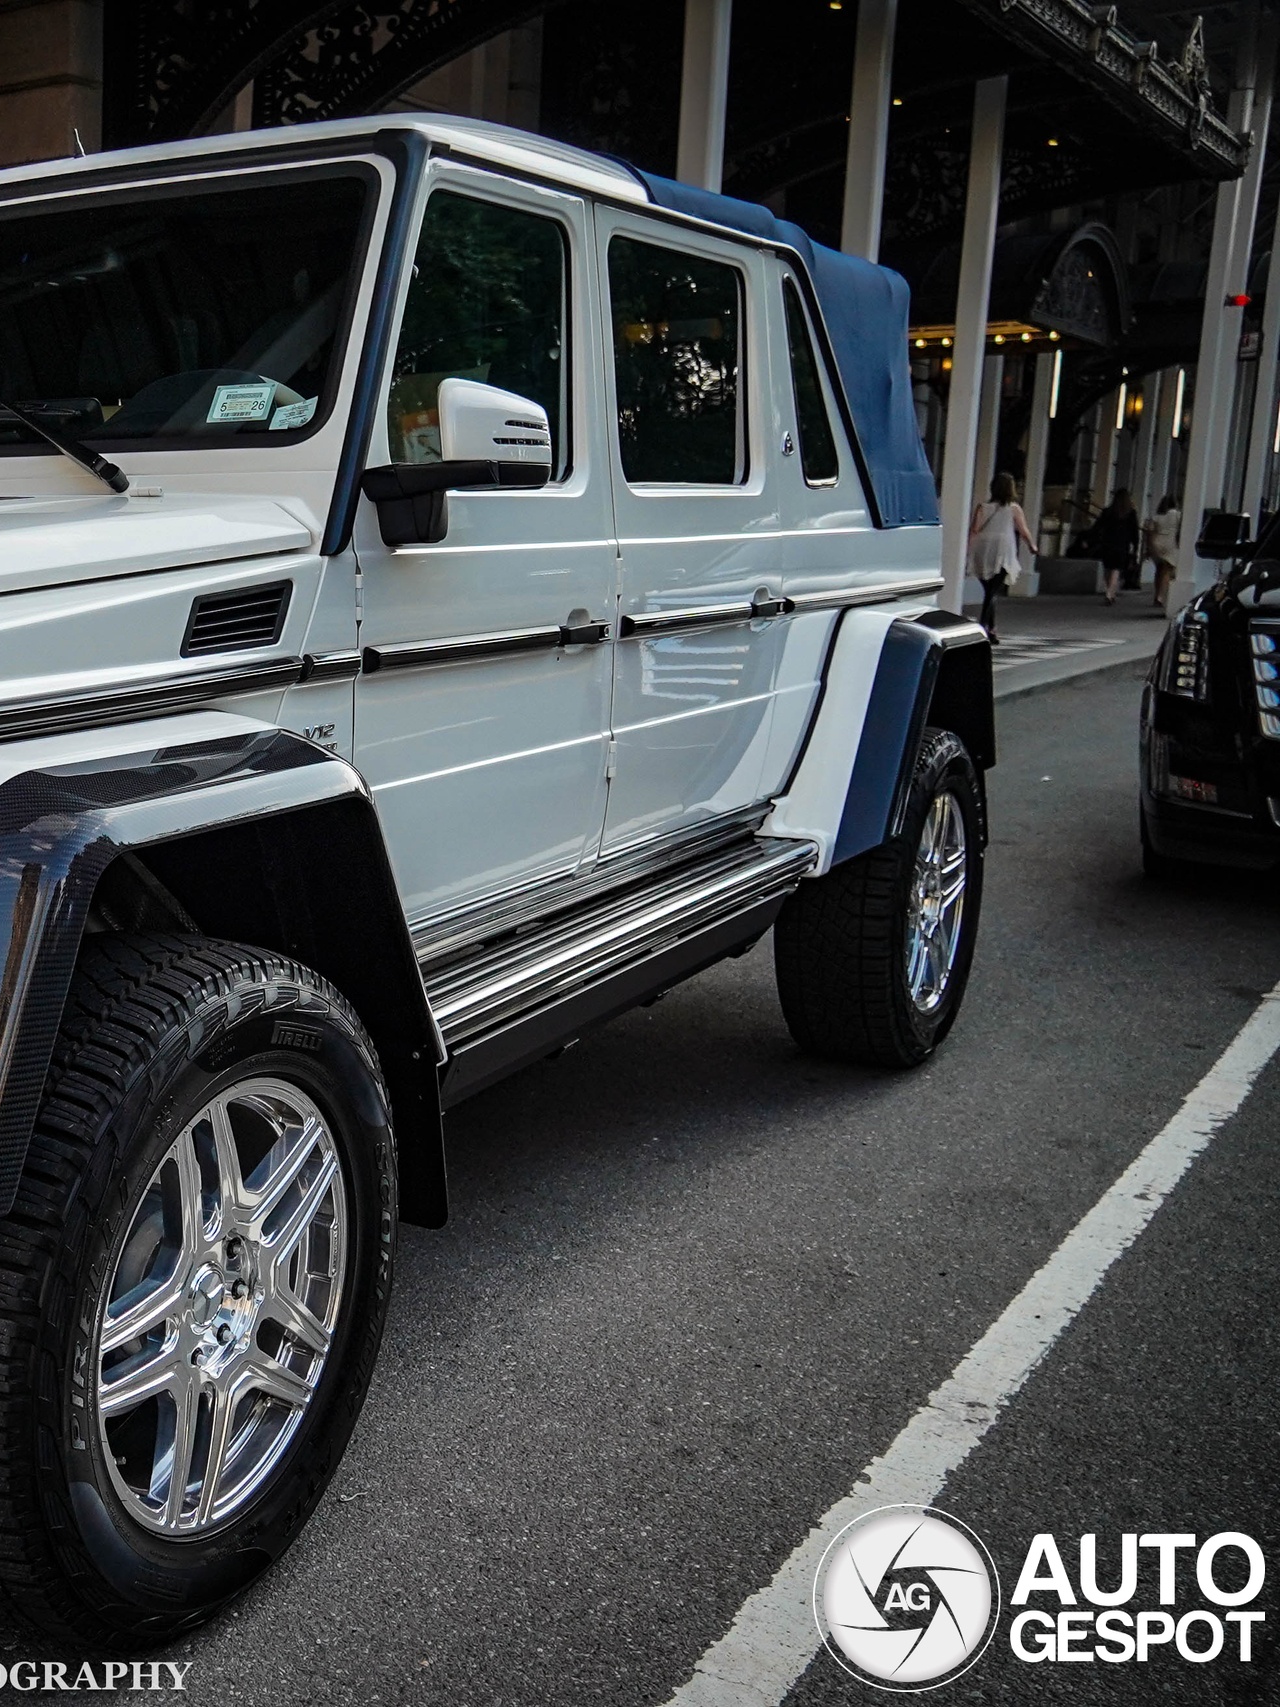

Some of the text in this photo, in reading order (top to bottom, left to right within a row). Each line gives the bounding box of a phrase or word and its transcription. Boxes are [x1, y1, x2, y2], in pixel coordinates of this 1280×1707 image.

[220, 402, 227, 412] 5
[251, 401, 266, 411] 26
[305, 723, 335, 739] V12
[270, 1020, 324, 1051] PIRELLI
[71, 1176, 129, 1450] PIRELLI
